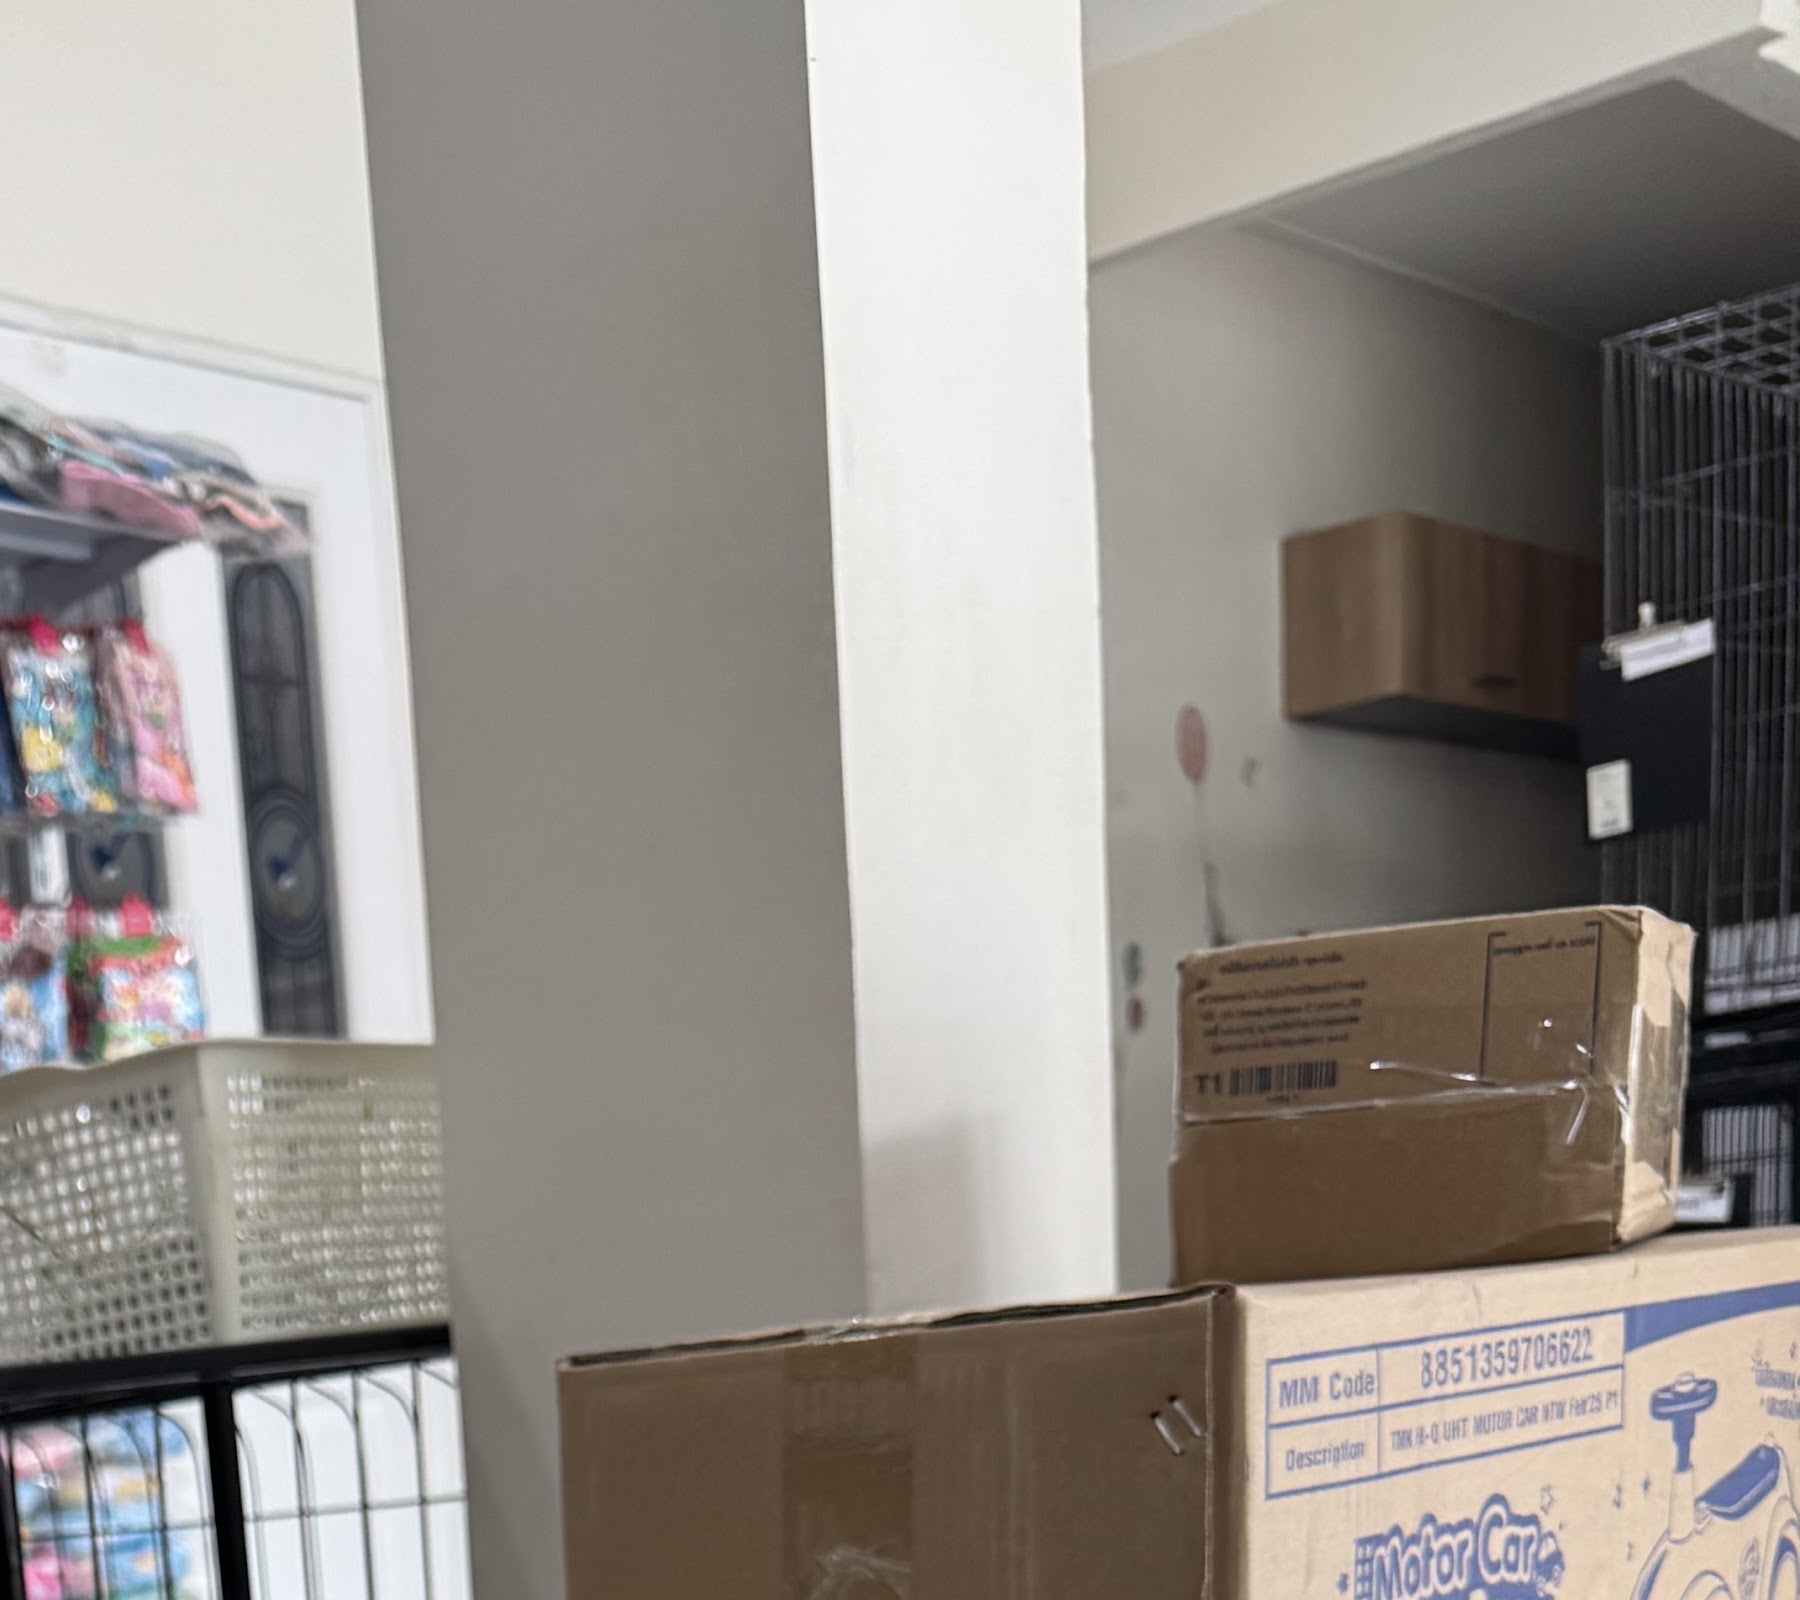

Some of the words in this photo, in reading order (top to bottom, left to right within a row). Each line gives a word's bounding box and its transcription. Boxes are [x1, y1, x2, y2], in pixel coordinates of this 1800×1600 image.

[1279, 1379, 1319, 1409] MM
[1329, 1370, 1375, 1400] Code
[1419, 1326, 1594, 1391] 8851359706622
[1285, 1440, 1366, 1472] Description
[1473, 1409, 1513, 1436] MOTOR
[1516, 1404, 1538, 1428] CAR
[1477, 1503, 1539, 1585] Car
